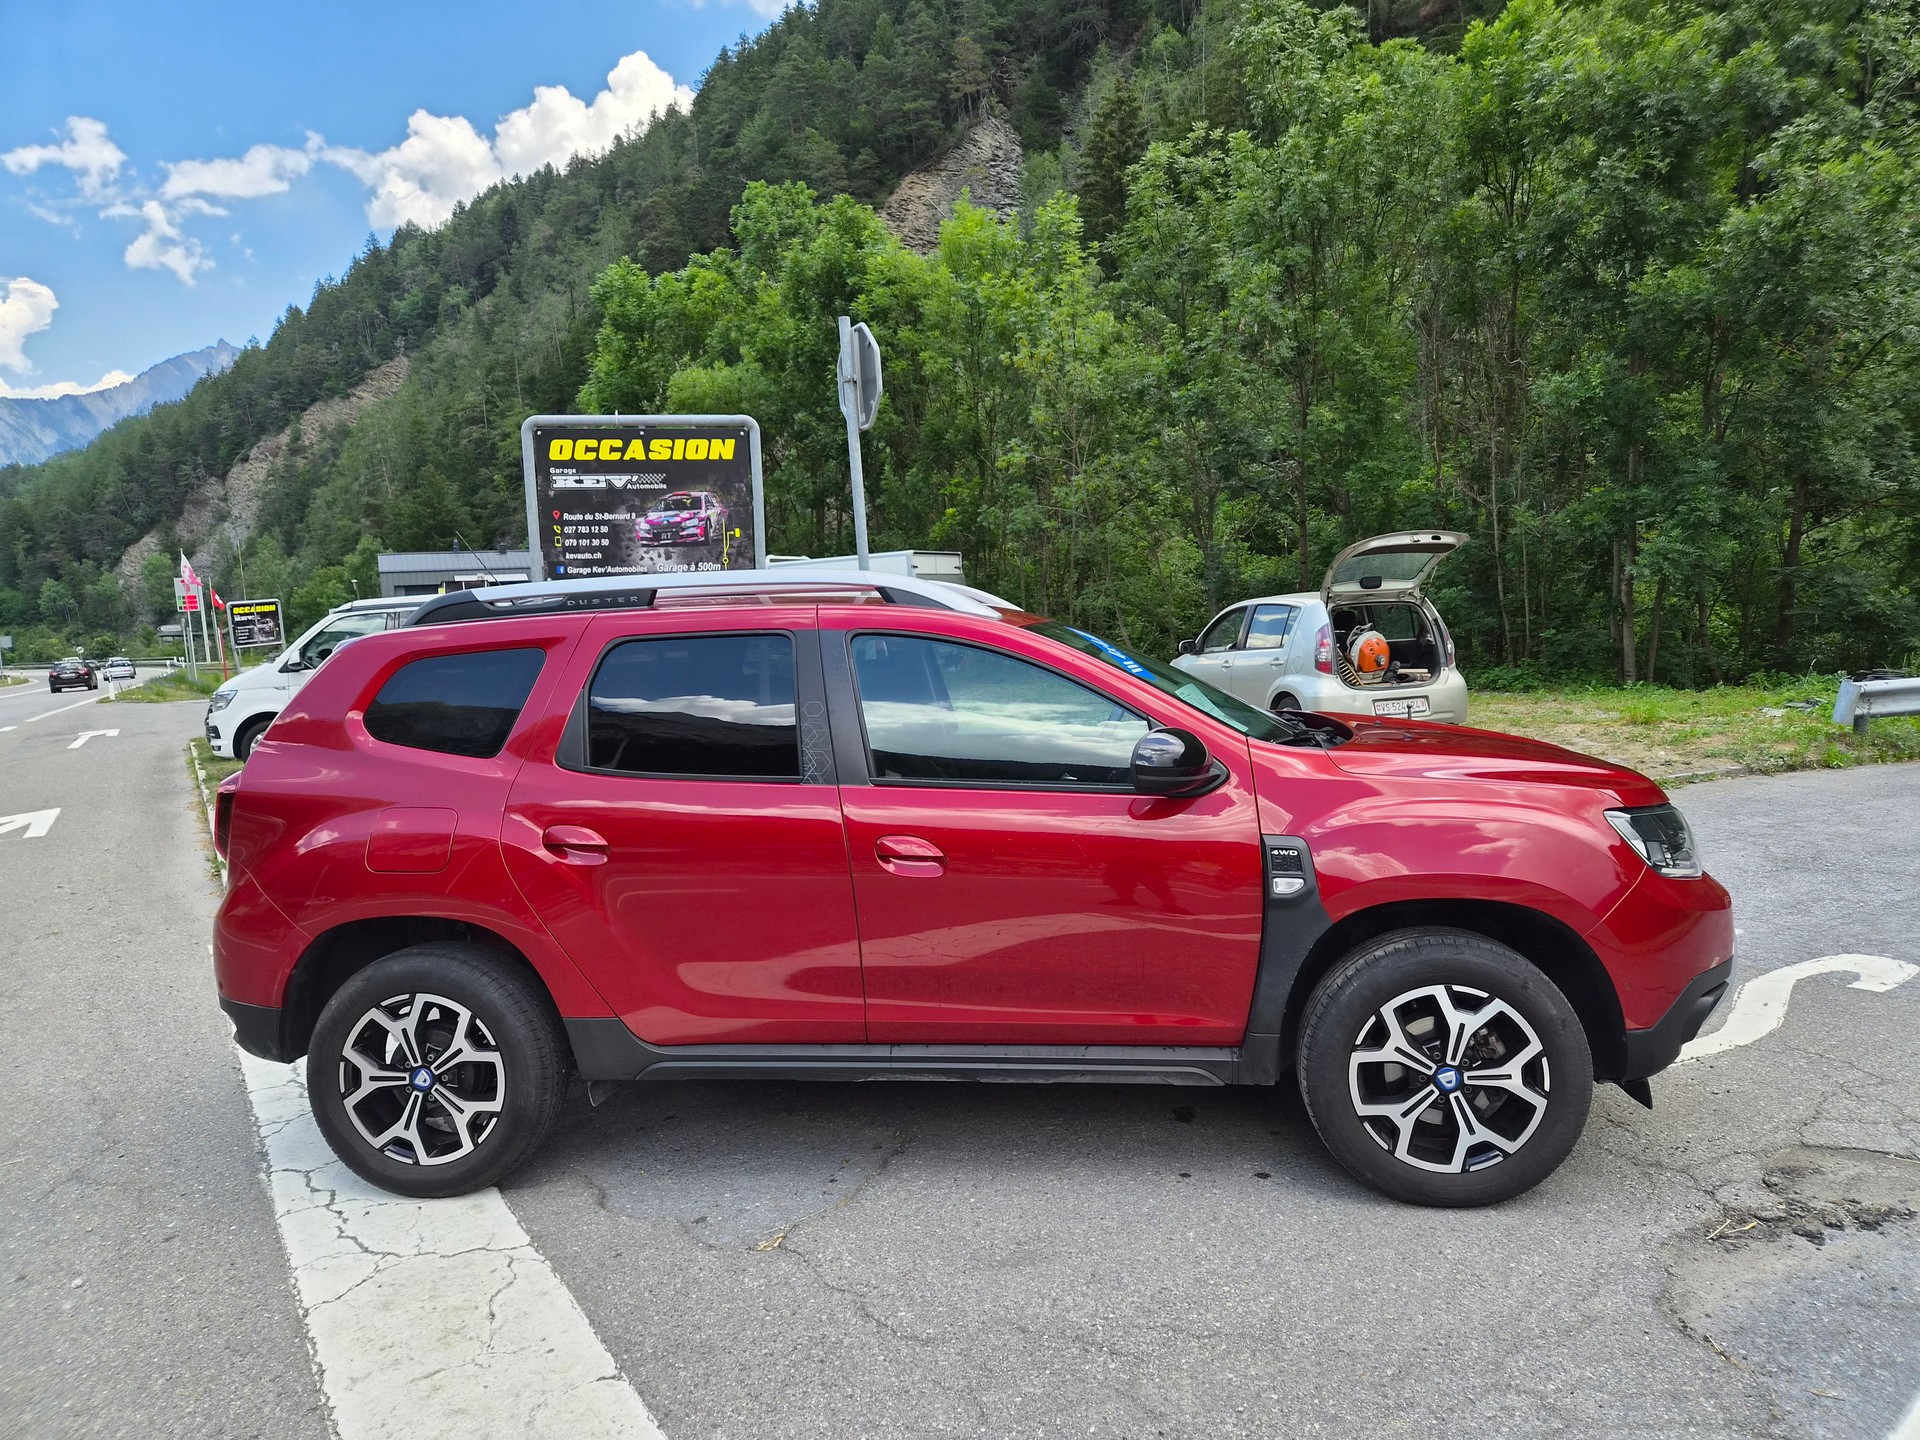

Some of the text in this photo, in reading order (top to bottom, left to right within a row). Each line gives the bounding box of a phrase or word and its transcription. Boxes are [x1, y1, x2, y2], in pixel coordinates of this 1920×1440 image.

[548, 438, 736, 461] OCCASION
[549, 467, 577, 475] Garage
[563, 512, 636, 520] Route du St-Bernard 8
[564, 525, 609, 533] 027 783 12 50
[565, 552, 602, 560] kevauto.ch
[567, 566, 591, 575] Garage
[656, 562, 721, 572] Garage à 500m
[566, 596, 638, 606] DUSTER
[233, 604, 276, 614] OCCASION
[1380, 703, 1391, 712] VS
